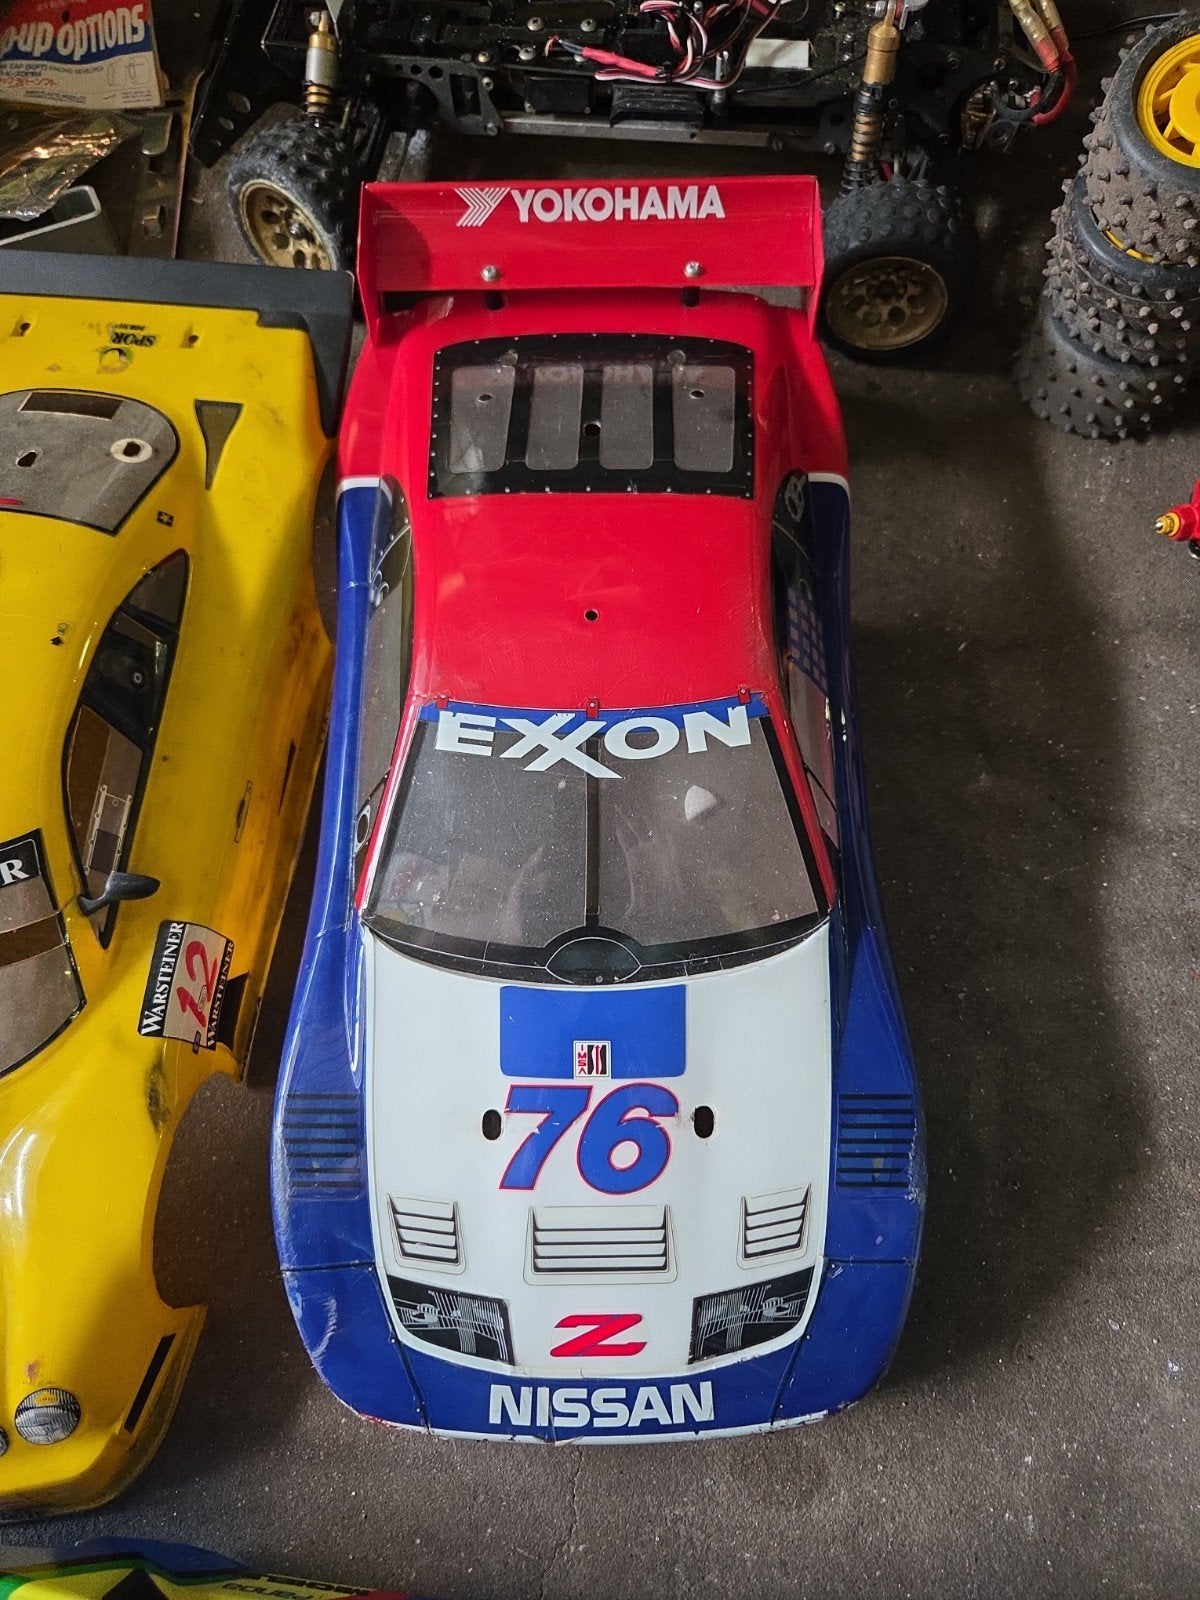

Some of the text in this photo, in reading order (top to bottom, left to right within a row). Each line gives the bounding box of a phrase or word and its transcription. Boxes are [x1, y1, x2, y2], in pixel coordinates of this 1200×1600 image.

[511, 185, 726, 223] YOKOHAMA
[434, 705, 752, 780] EXXON
[141, 922, 184, 1035] WARSTEINER
[176, 940, 218, 1028] 12
[577, 1043, 587, 1075] IMSA
[499, 1082, 680, 1195] 76
[549, 1313, 648, 1358] Z
[489, 1380, 715, 1429] NISSAN
